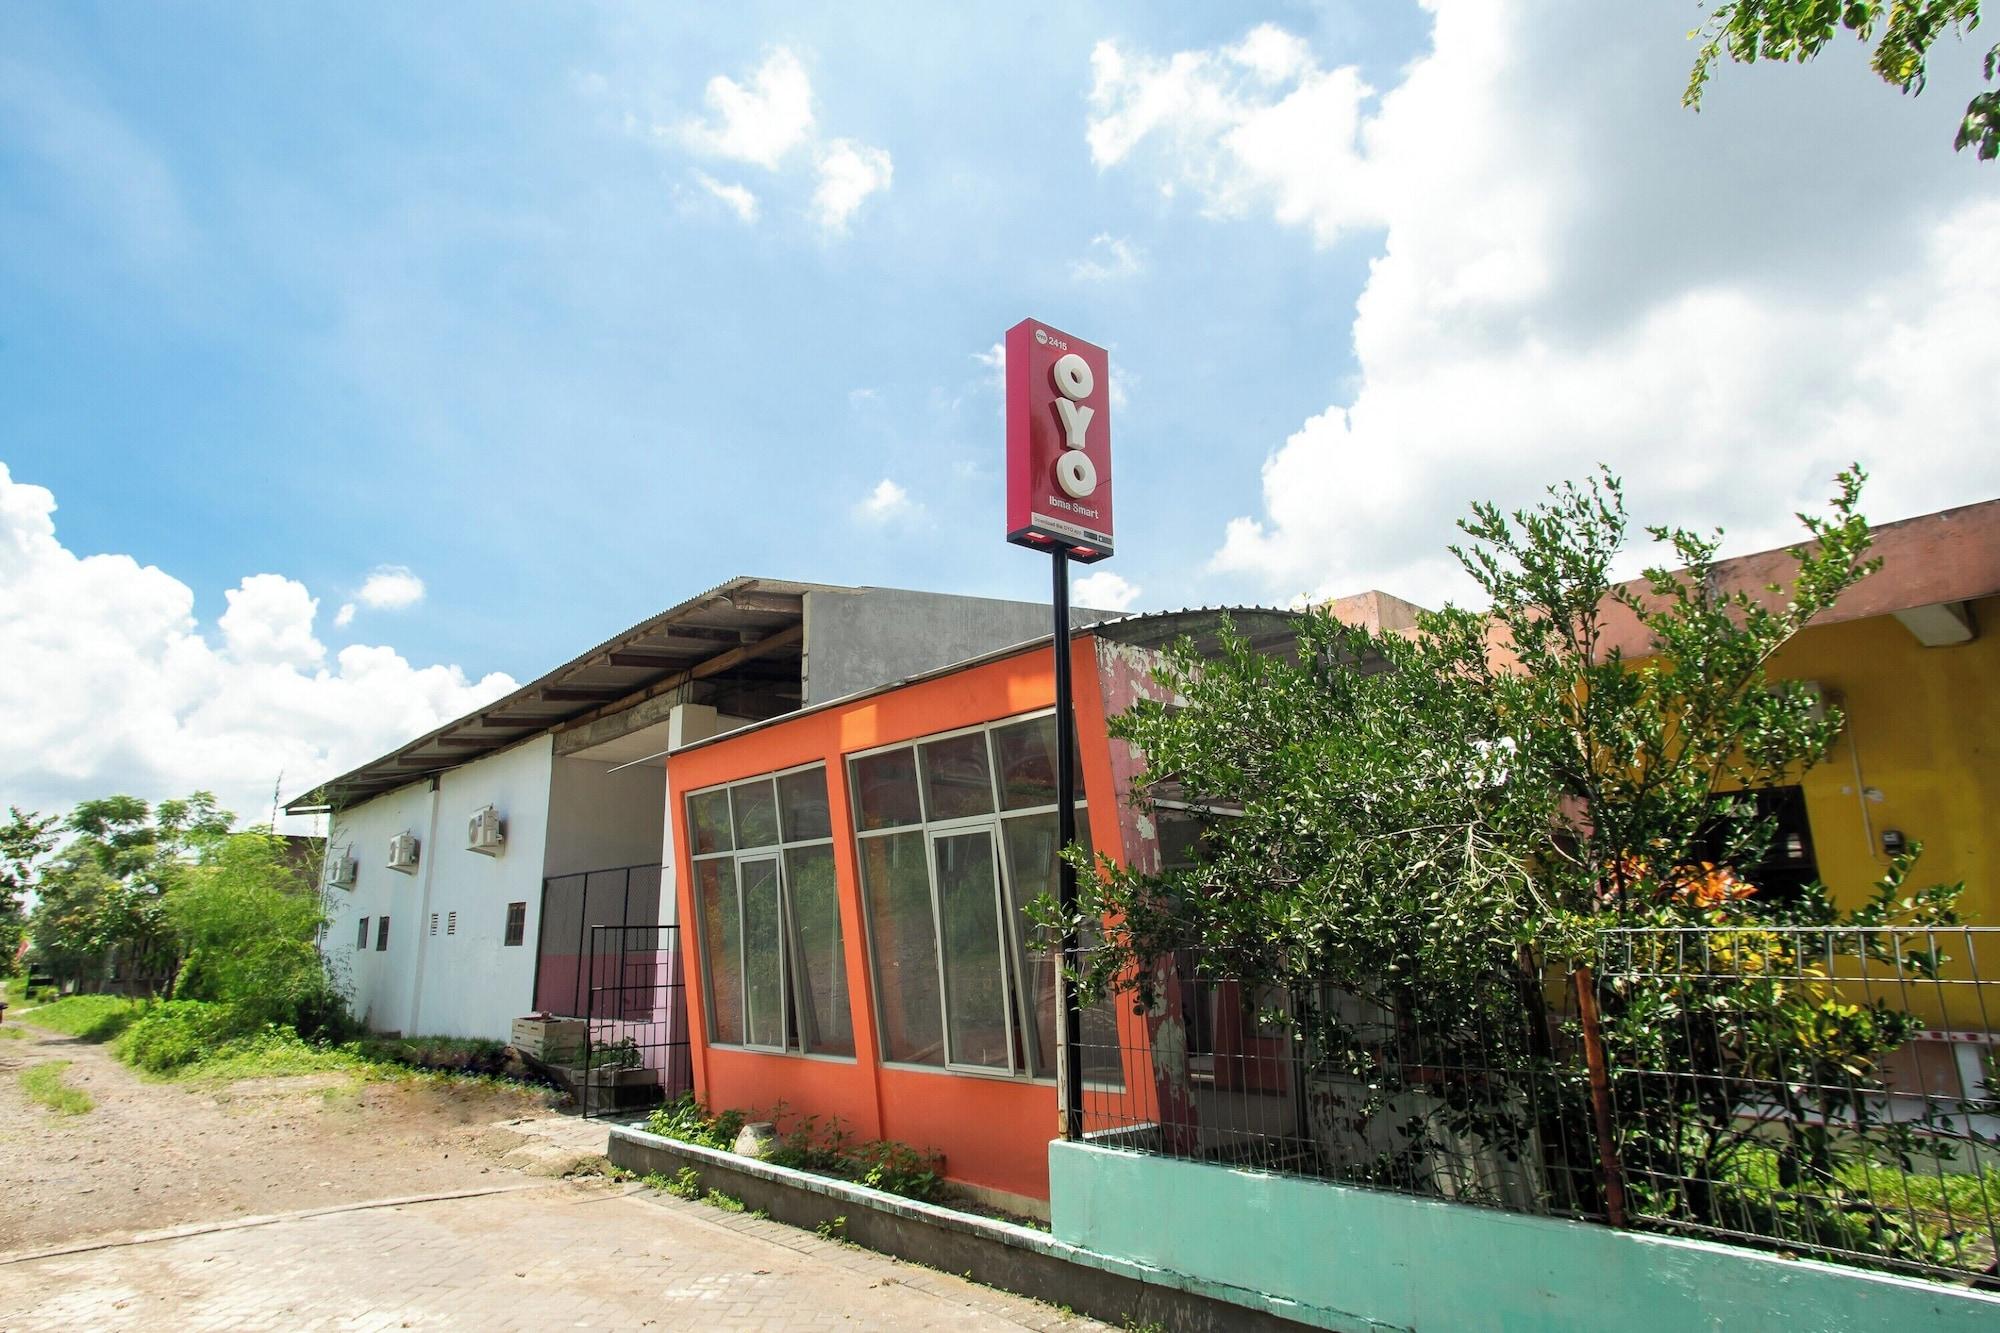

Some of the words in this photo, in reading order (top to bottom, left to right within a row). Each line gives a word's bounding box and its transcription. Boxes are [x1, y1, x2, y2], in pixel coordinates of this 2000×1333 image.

[1048, 337, 1067, 350] 2415
[1053, 353, 1097, 499] OYO
[1049, 495, 1071, 510] Ibma
[1072, 503, 1099, 519] Smart
